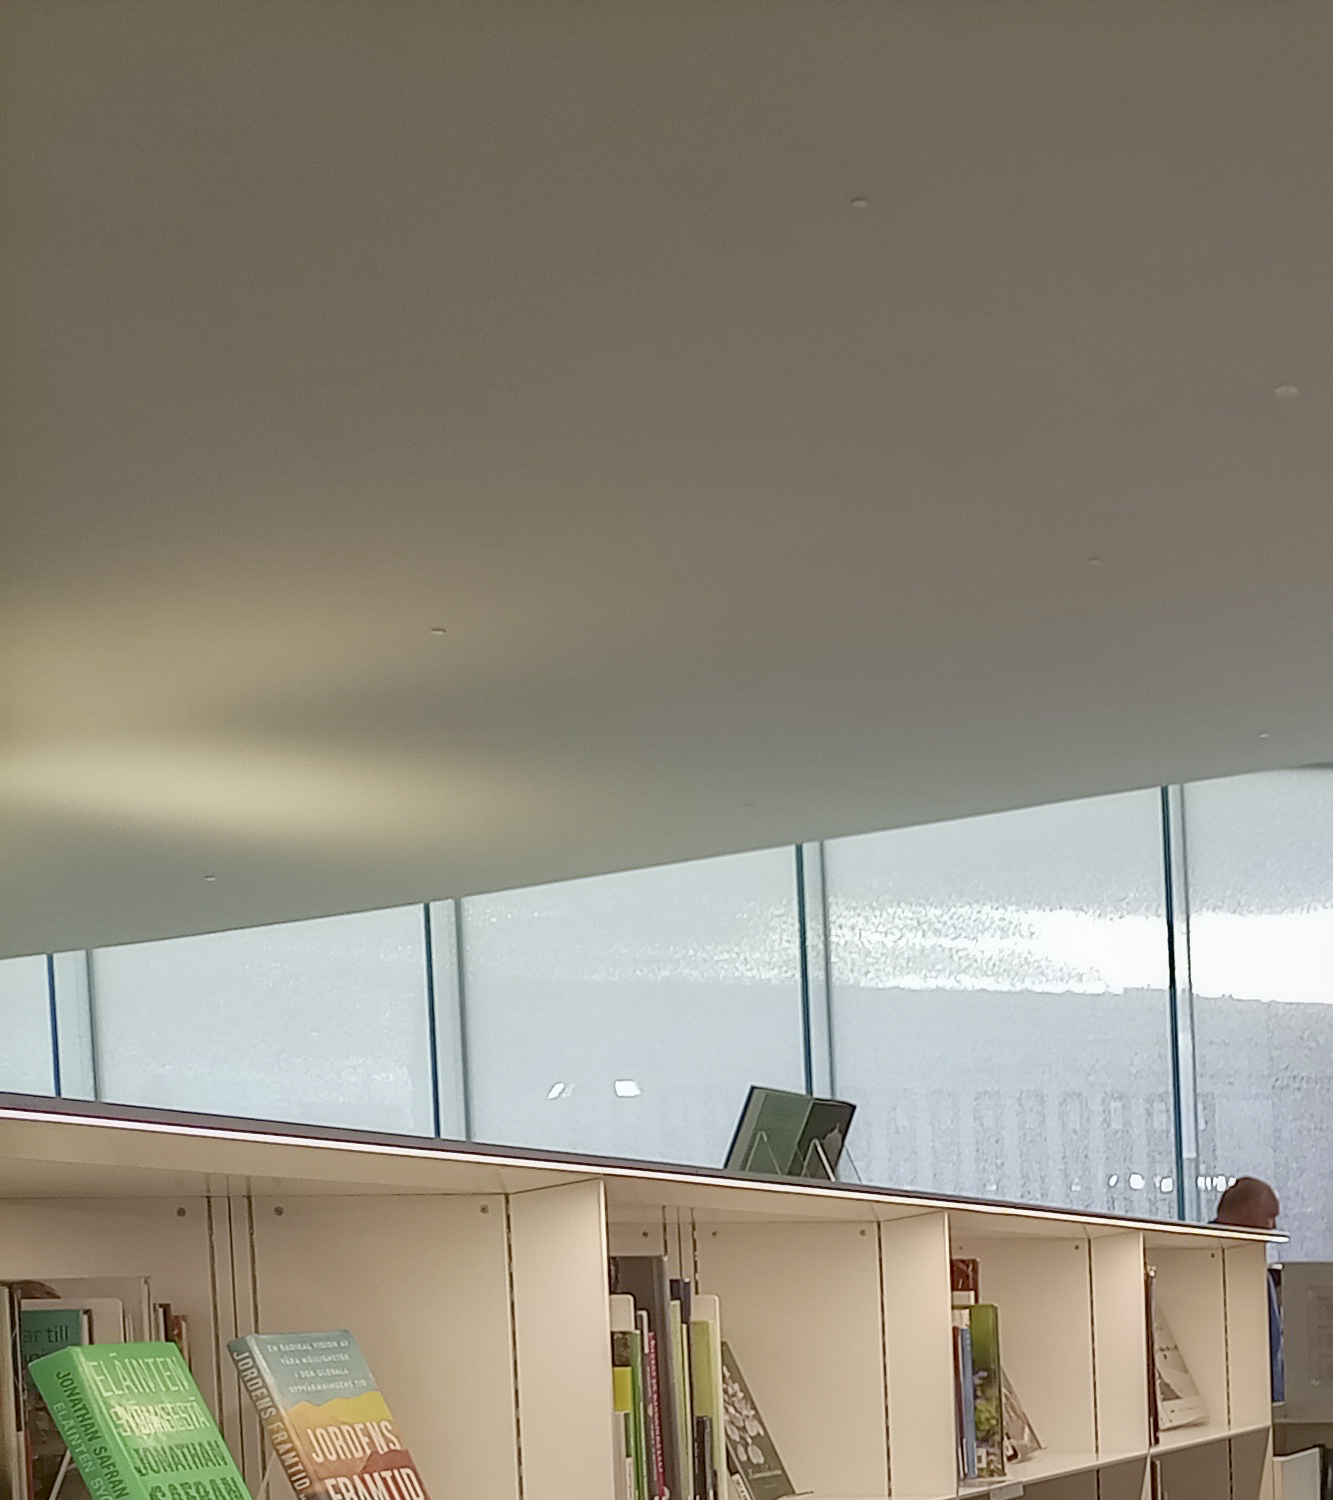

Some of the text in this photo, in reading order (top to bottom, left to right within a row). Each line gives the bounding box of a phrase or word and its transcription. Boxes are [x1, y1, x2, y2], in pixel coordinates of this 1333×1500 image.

[47, 1326, 68, 1342] till
[84, 1352, 190, 1398] ELÄINTEN
[56, 1370, 101, 1442] JONATHAN
[93, 1446, 130, 1499] SAFRAN
[233, 1350, 311, 1492] JORDENS FRAMTID
[306, 1420, 402, 1464] JORDENS
[133, 1439, 228, 1477] JONATHAN
